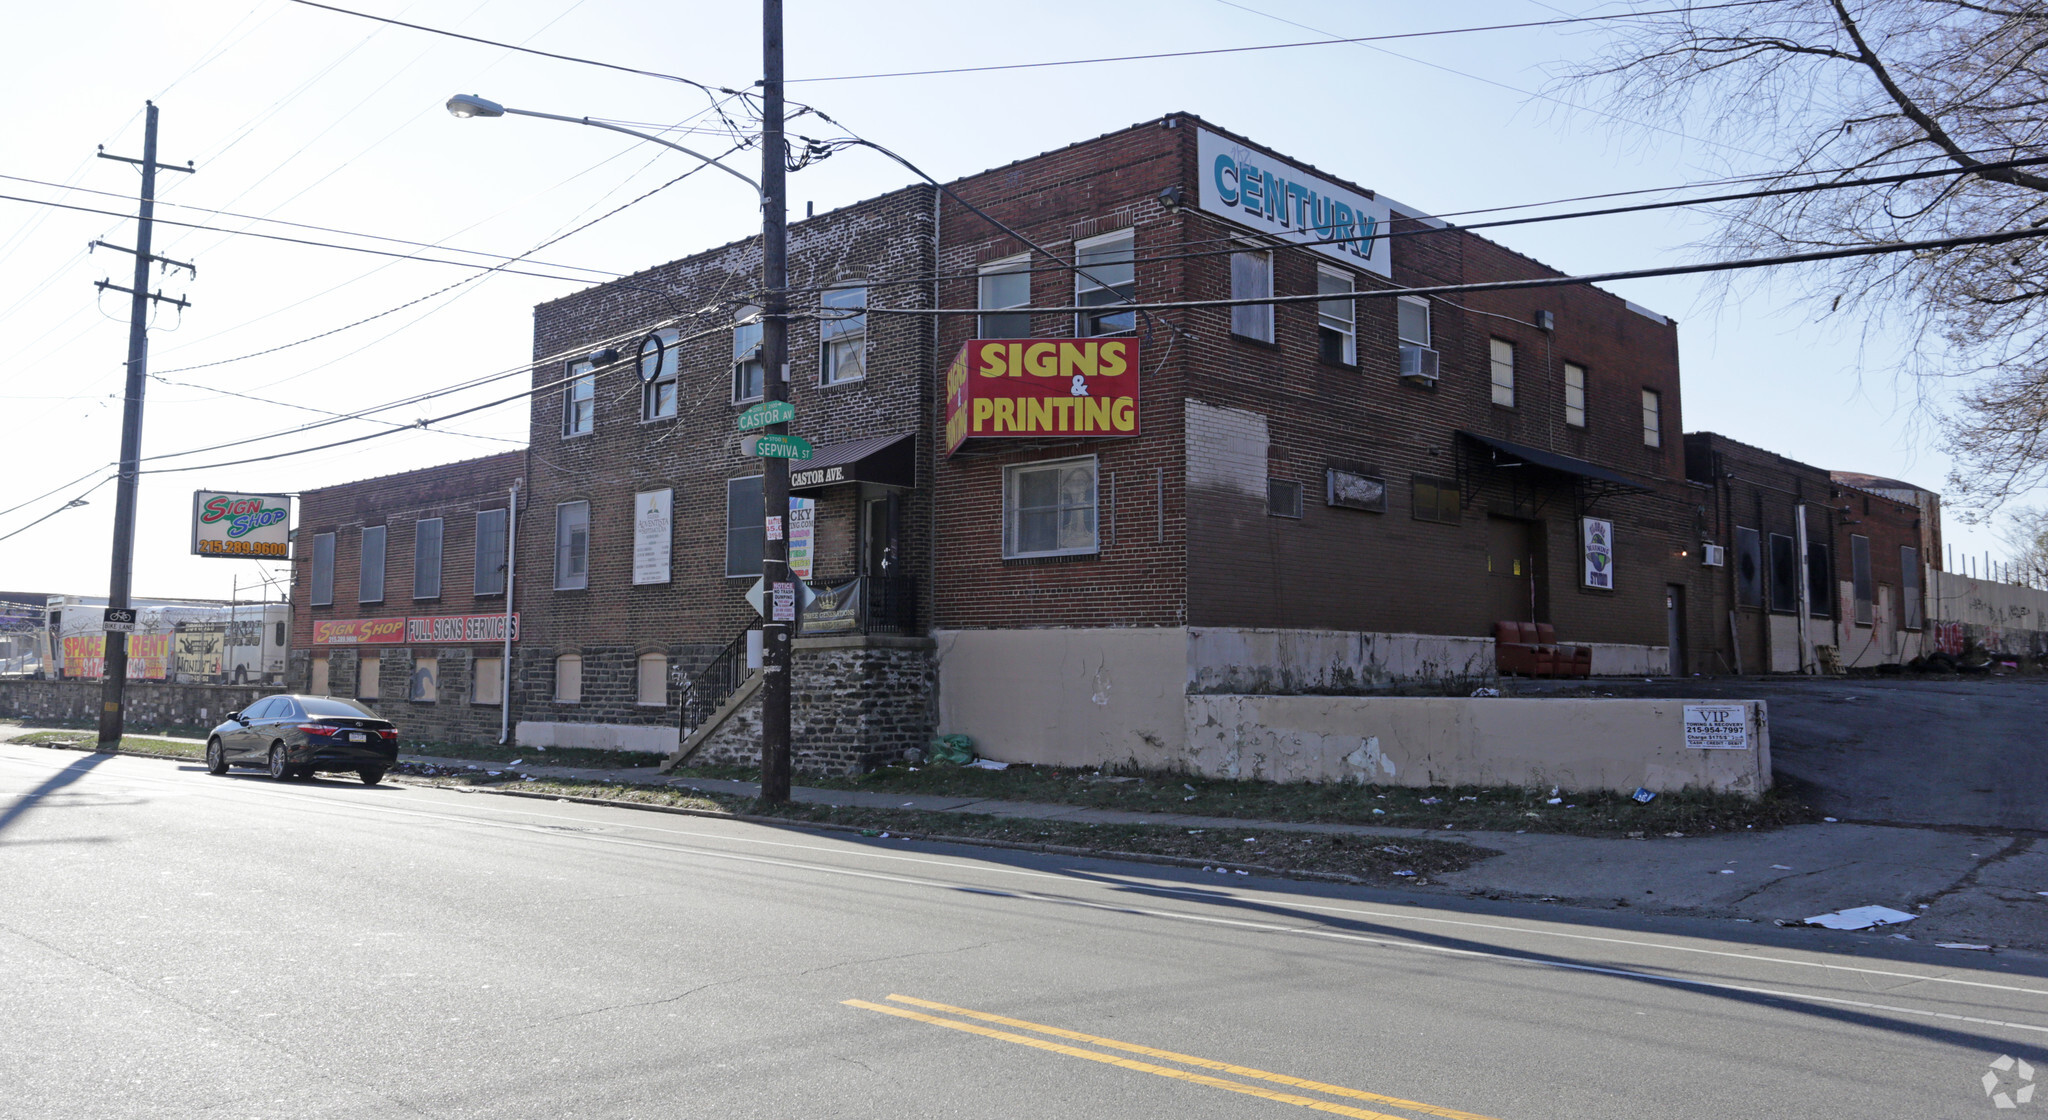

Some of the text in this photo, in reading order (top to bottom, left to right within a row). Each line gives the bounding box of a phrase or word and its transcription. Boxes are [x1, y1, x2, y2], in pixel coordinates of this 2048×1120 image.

[1213, 153, 1378, 261] CENTURY
[979, 341, 1128, 378] SIGNS
[946, 348, 968, 405] SIGNS
[1070, 374, 1089, 397] &
[740, 409, 792, 429] CASTOR AV
[972, 396, 1135, 432] PRINTING
[758, 443, 810, 459] SEPVIVA ST
[791, 467, 844, 487] CASTOR AVE.
[203, 498, 262, 522] SIGN
[230, 511, 285, 536] SHOP
[199, 540, 287, 555] 215.289.9600
[820, 608, 855, 619] GENERATIONS
[104, 622, 133, 631] BIKE LANE
[317, 621, 404, 642] SIGN SHOP
[408, 619, 432, 641] FULL
[433, 617, 464, 640] SIGNS
[64, 636, 102, 657] SPACE
[132, 635, 168, 657] RENT
[1699, 711, 1729, 723] VIP
